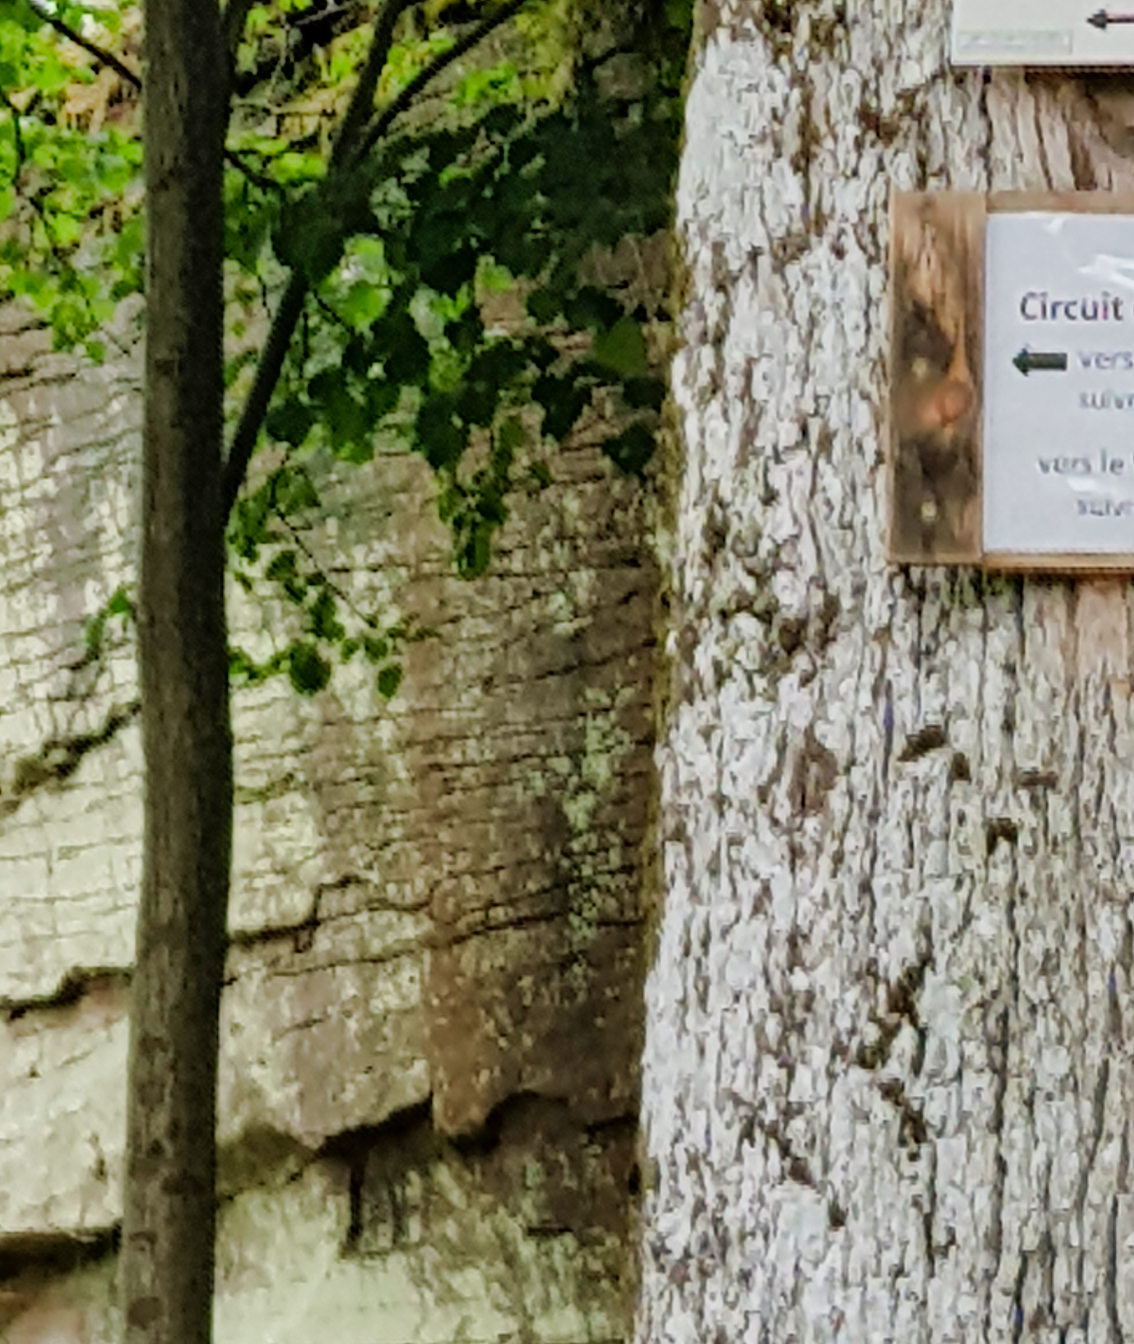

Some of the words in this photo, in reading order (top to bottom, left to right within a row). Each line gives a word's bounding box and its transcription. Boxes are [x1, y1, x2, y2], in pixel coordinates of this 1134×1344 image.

[1020, 291, 1124, 322] Circuit
[1079, 349, 1134, 370] vers
[1038, 454, 1092, 475] vers
[1100, 448, 1125, 475] le
